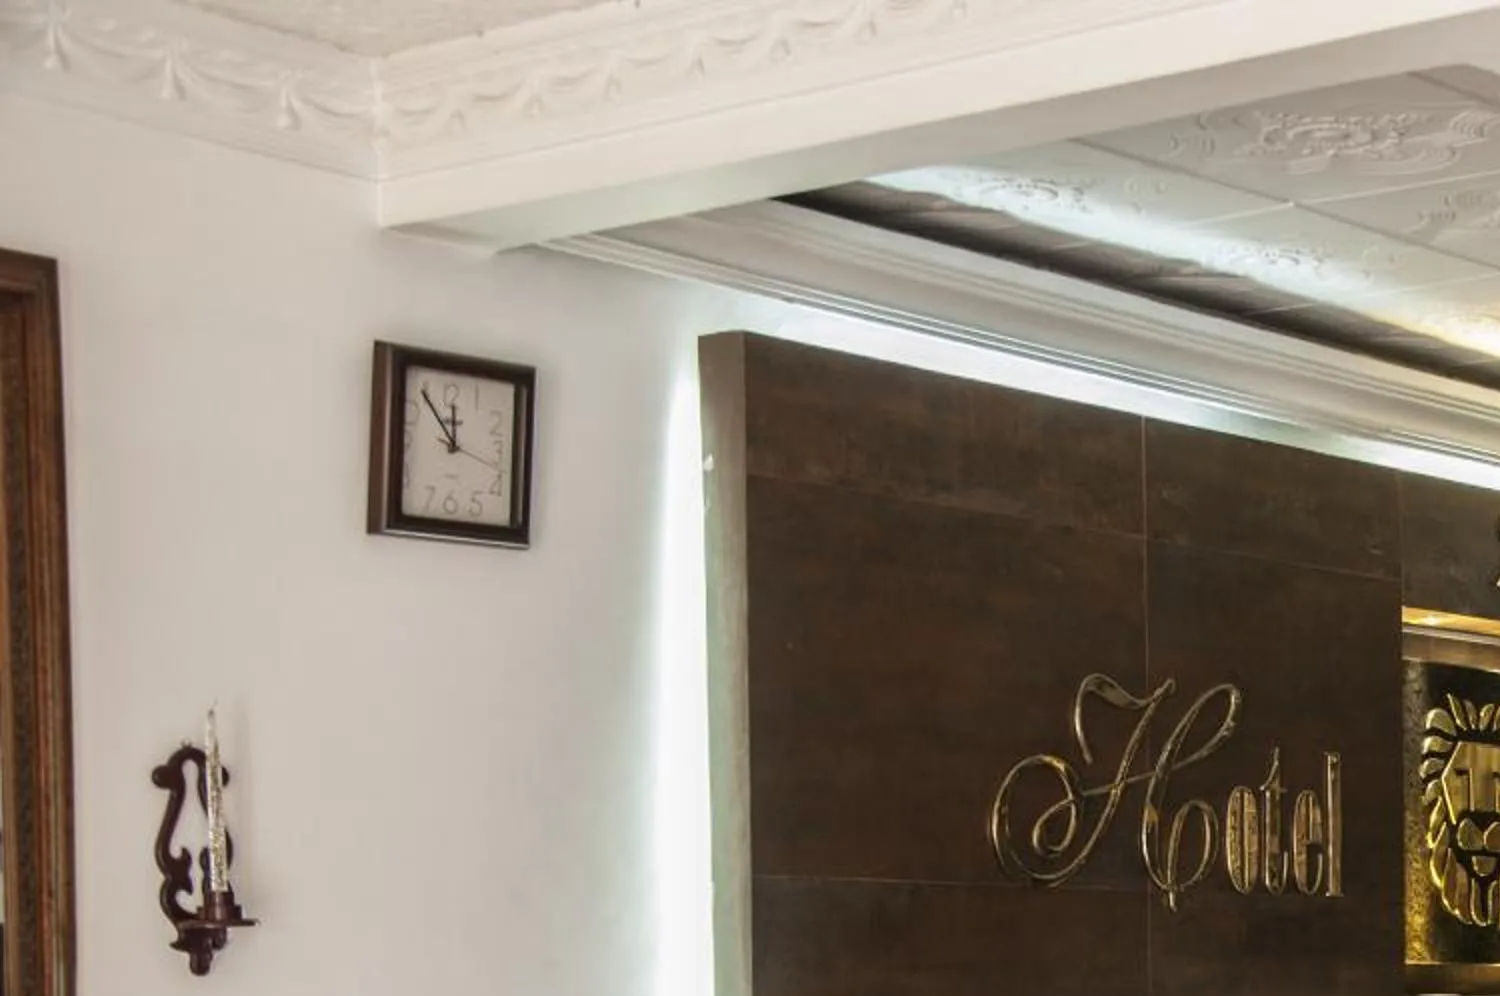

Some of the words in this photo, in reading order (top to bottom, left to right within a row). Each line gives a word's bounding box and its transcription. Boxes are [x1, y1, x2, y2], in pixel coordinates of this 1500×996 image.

[442, 489, 458, 515] 6
[469, 490, 483, 517] 5
[987, 672, 1344, 911] Hotel
